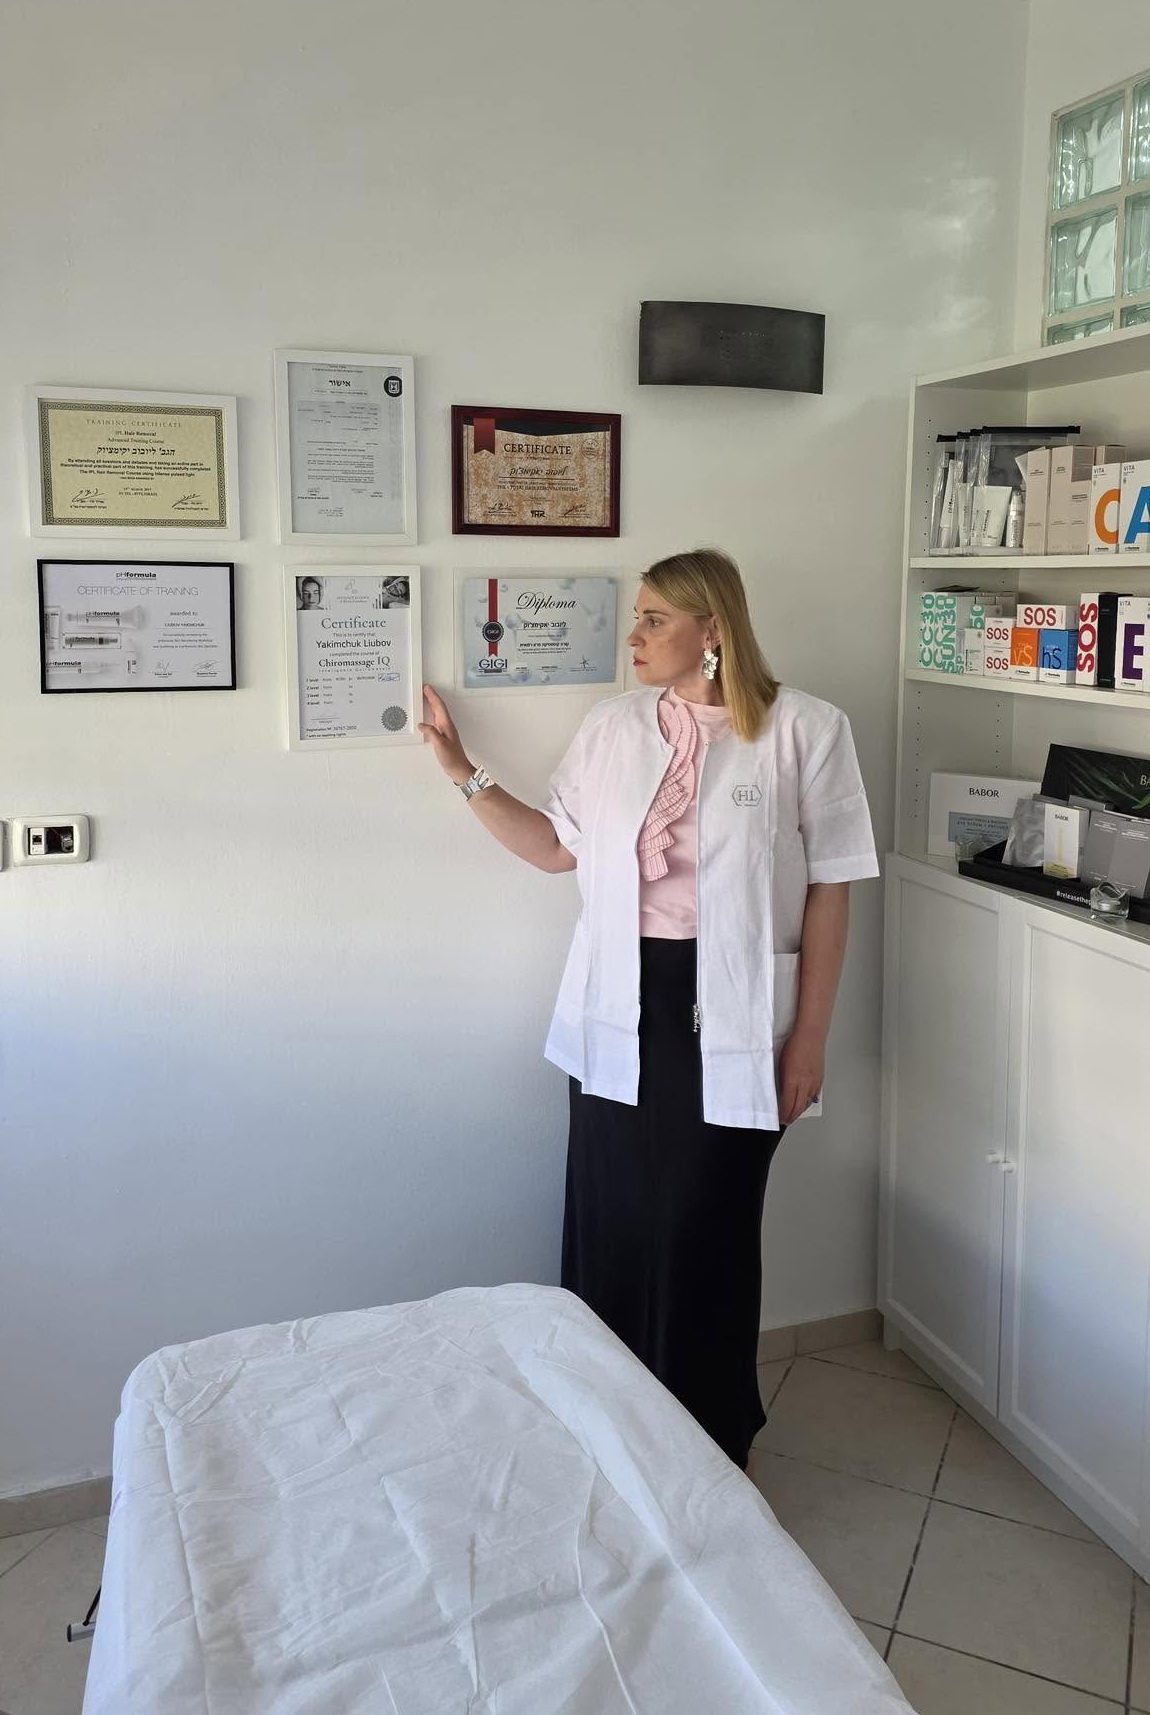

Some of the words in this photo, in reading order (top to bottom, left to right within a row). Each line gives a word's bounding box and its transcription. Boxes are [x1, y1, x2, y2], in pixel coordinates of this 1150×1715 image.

[86, 419, 127, 427] TRAINING
[132, 446, 156, 455] ליובוב
[504, 444, 572, 455] CERTIFICATE
[77, 586, 137, 596] CERTIFICATE
[139, 586, 153, 596] OF
[156, 587, 199, 596] TRAINING
[516, 592, 577, 615] Diploma
[321, 616, 386, 629] Certificate
[1024, 607, 1056, 626] SOS
[986, 627, 1009, 640] SOS
[1077, 602, 1098, 673] SOS
[316, 640, 361, 649] Yakimchuk
[364, 639, 391, 647] Liubov
[921, 625, 933, 667] CC
[942, 625, 956, 674] SUN
[1122, 623, 1145, 680] E
[318, 658, 375, 668] Chiromassage
[377, 656, 390, 668] IQ
[478, 659, 507, 669] GIGI
[986, 657, 1009, 670] SOS
[969, 787, 1000, 798] BABOR
[1055, 813, 1068, 821] BABOR
